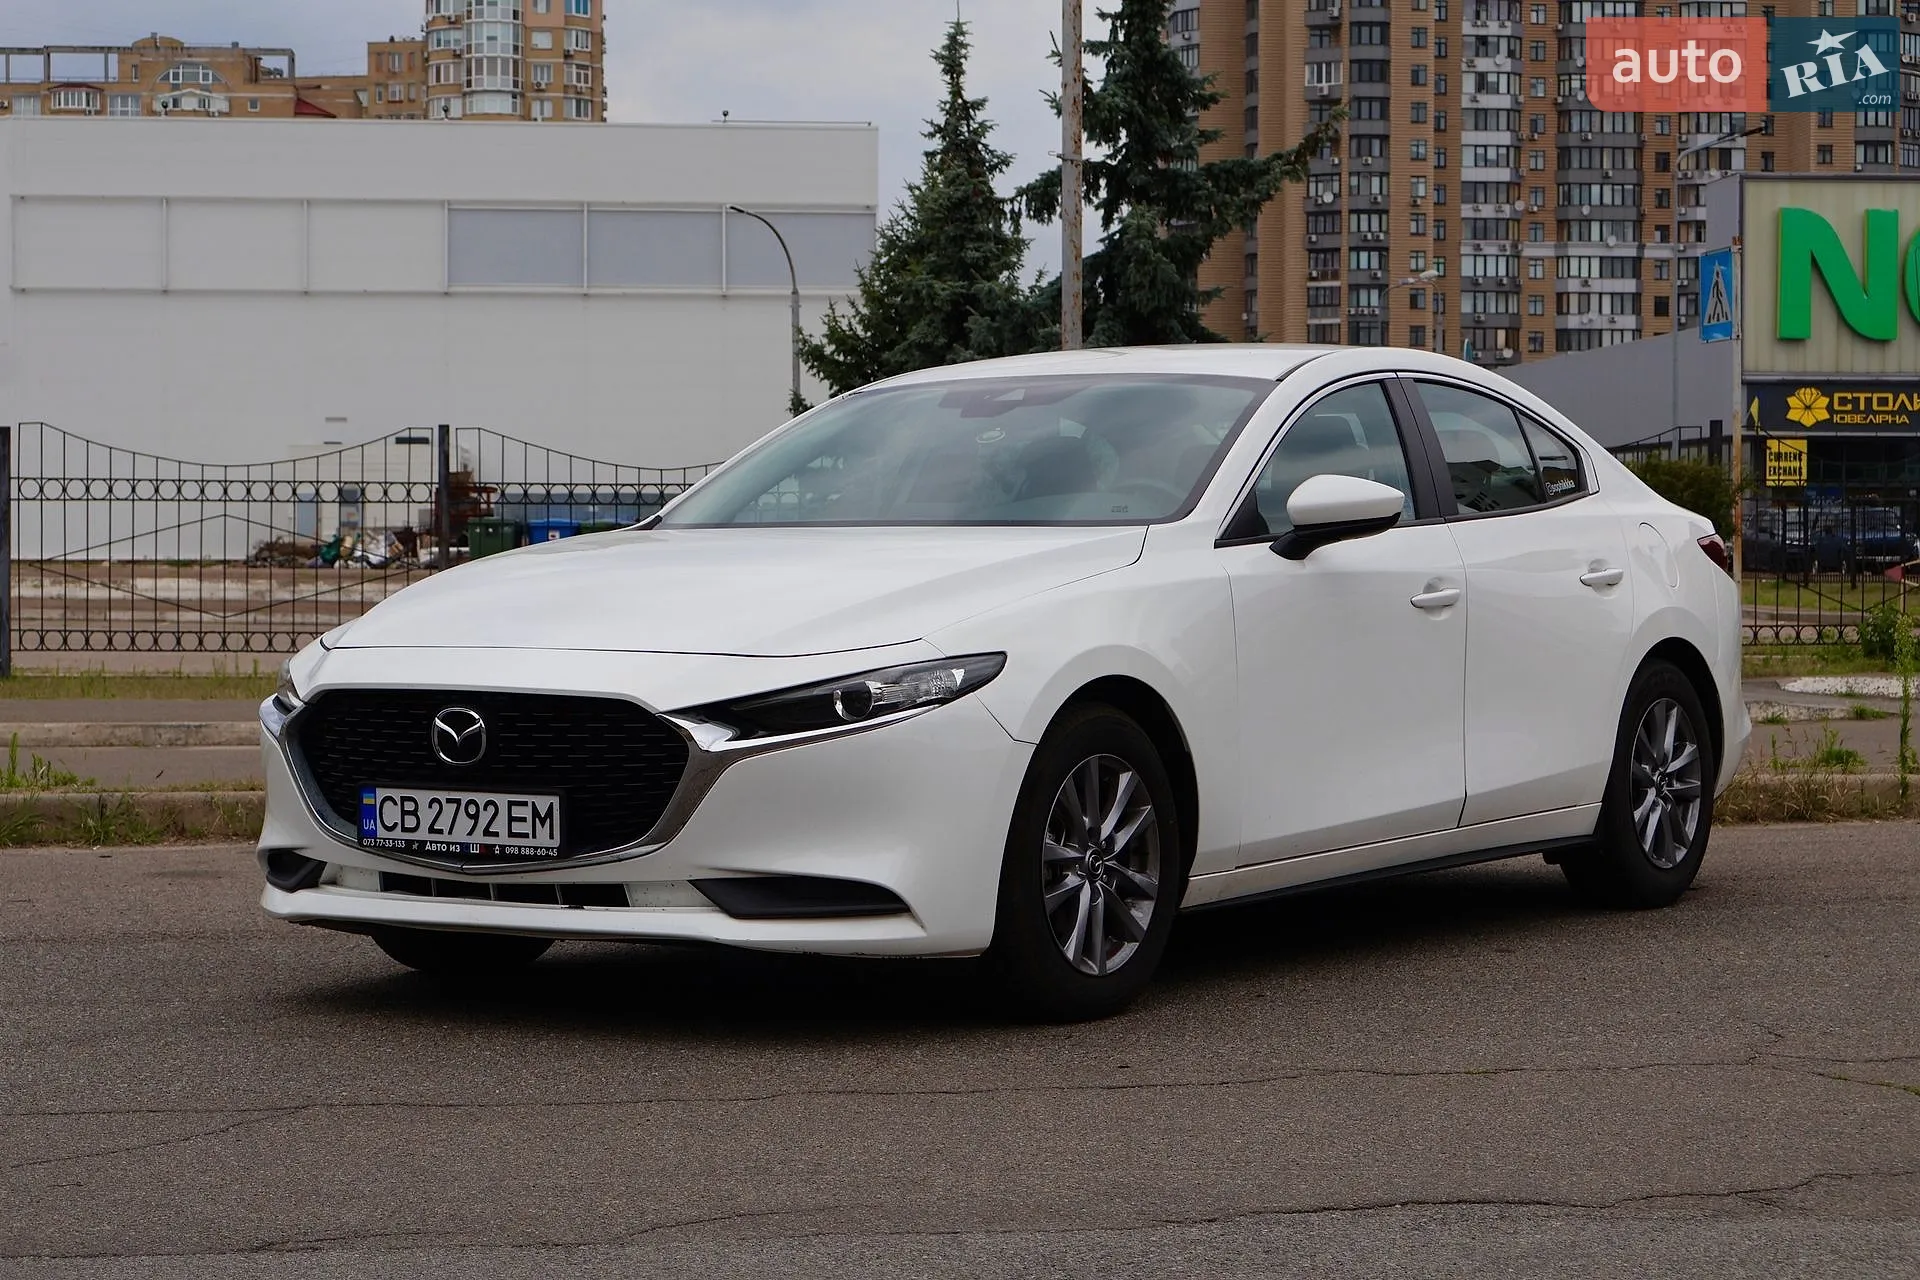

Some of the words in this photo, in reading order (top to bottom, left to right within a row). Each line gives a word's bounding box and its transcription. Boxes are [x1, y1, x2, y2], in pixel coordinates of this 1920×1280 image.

[1777, 207, 1920, 340] N
[363, 818, 376, 831] UA
[425, 841, 447, 852] Авто
